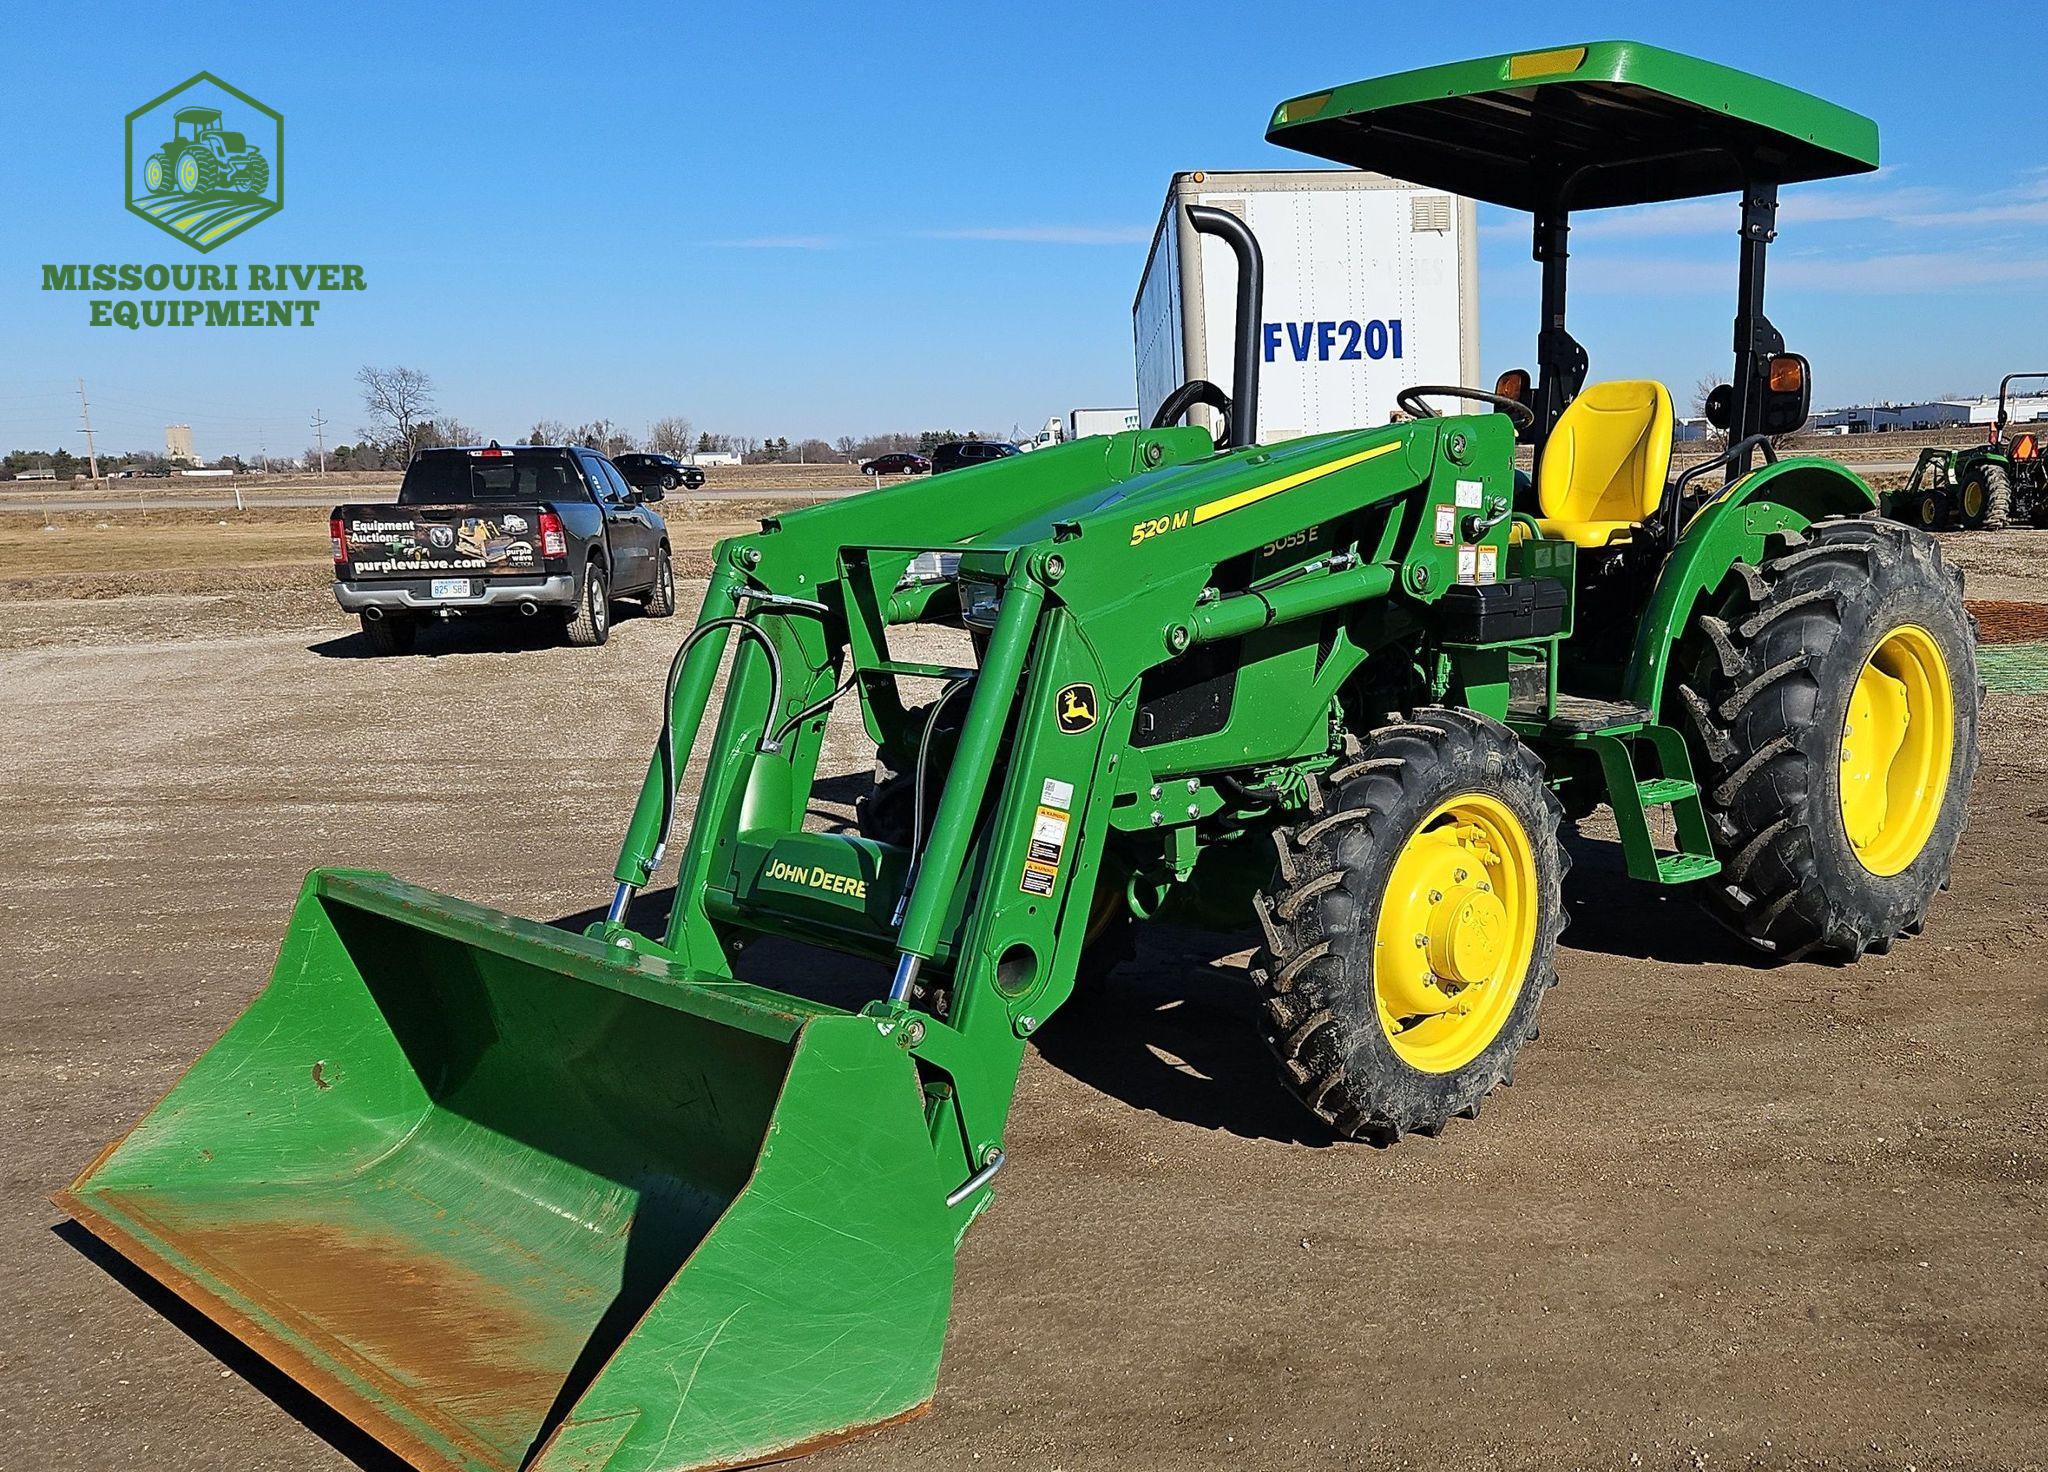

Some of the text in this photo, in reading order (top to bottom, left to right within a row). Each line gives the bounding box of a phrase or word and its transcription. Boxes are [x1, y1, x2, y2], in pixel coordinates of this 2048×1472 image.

[1263, 319, 1403, 363] FVF201
[352, 520, 415, 533] Equipment
[351, 532, 400, 543] Auctions
[506, 548, 532, 557] purple
[354, 558, 487, 574] purplewave.com
[765, 859, 867, 899] JOHN DEERE
